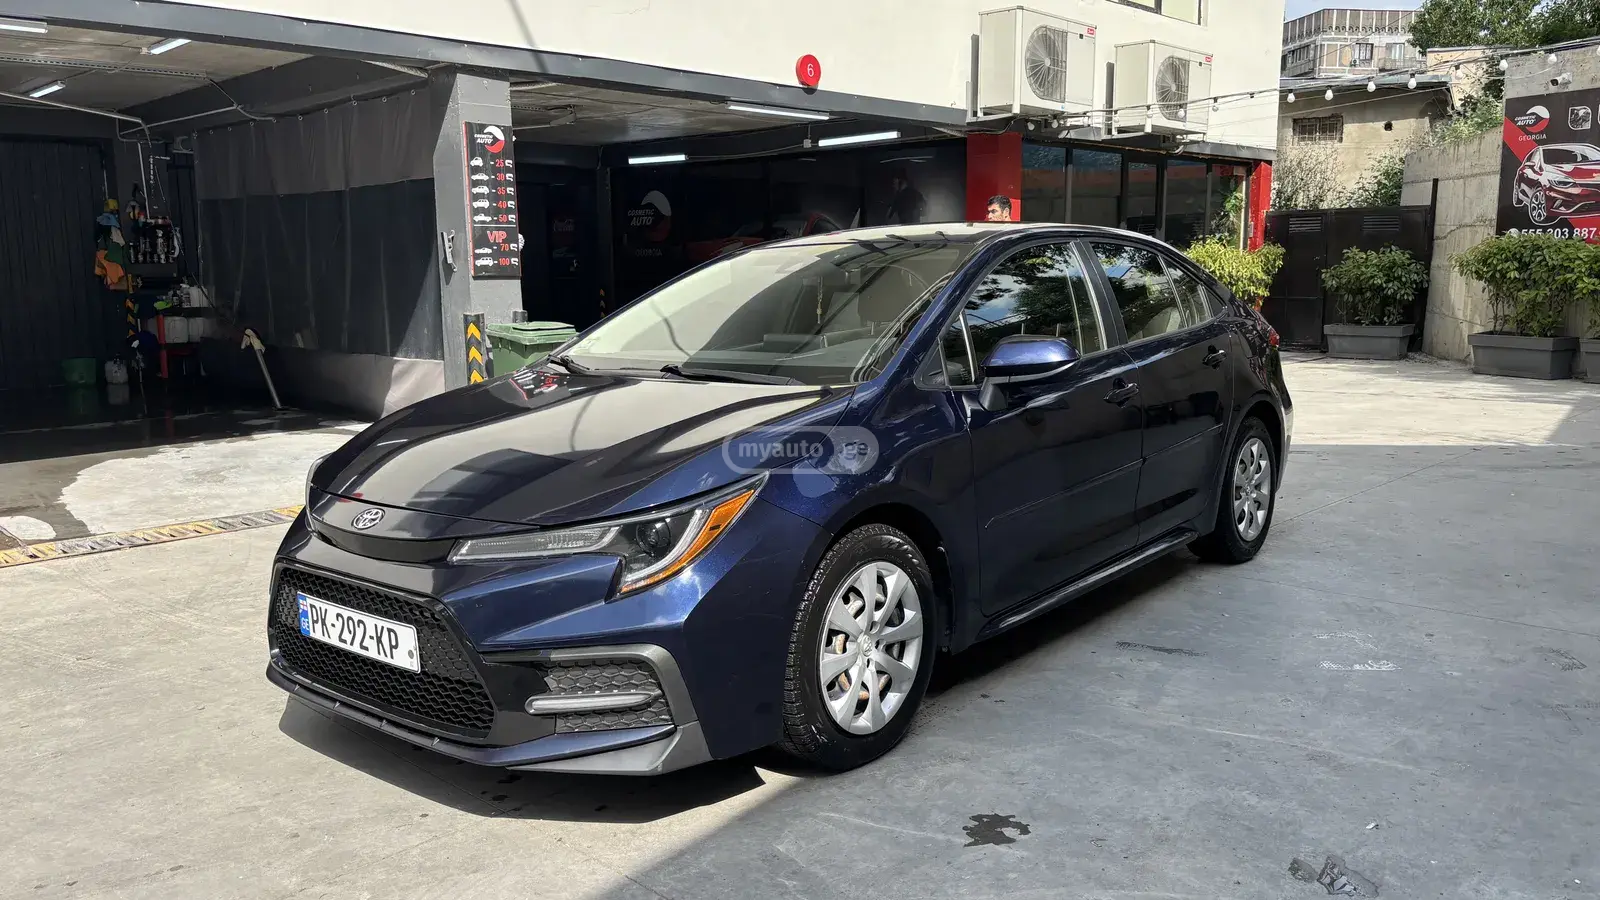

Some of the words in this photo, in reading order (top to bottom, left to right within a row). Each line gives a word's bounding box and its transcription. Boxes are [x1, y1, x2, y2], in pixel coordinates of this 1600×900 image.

[807, 63, 815, 77] 6
[631, 217, 654, 226] AUTO
[487, 231, 507, 243] VIP
[1573, 228, 1597, 239] 887
[309, 603, 399, 660] PK-292-KP
